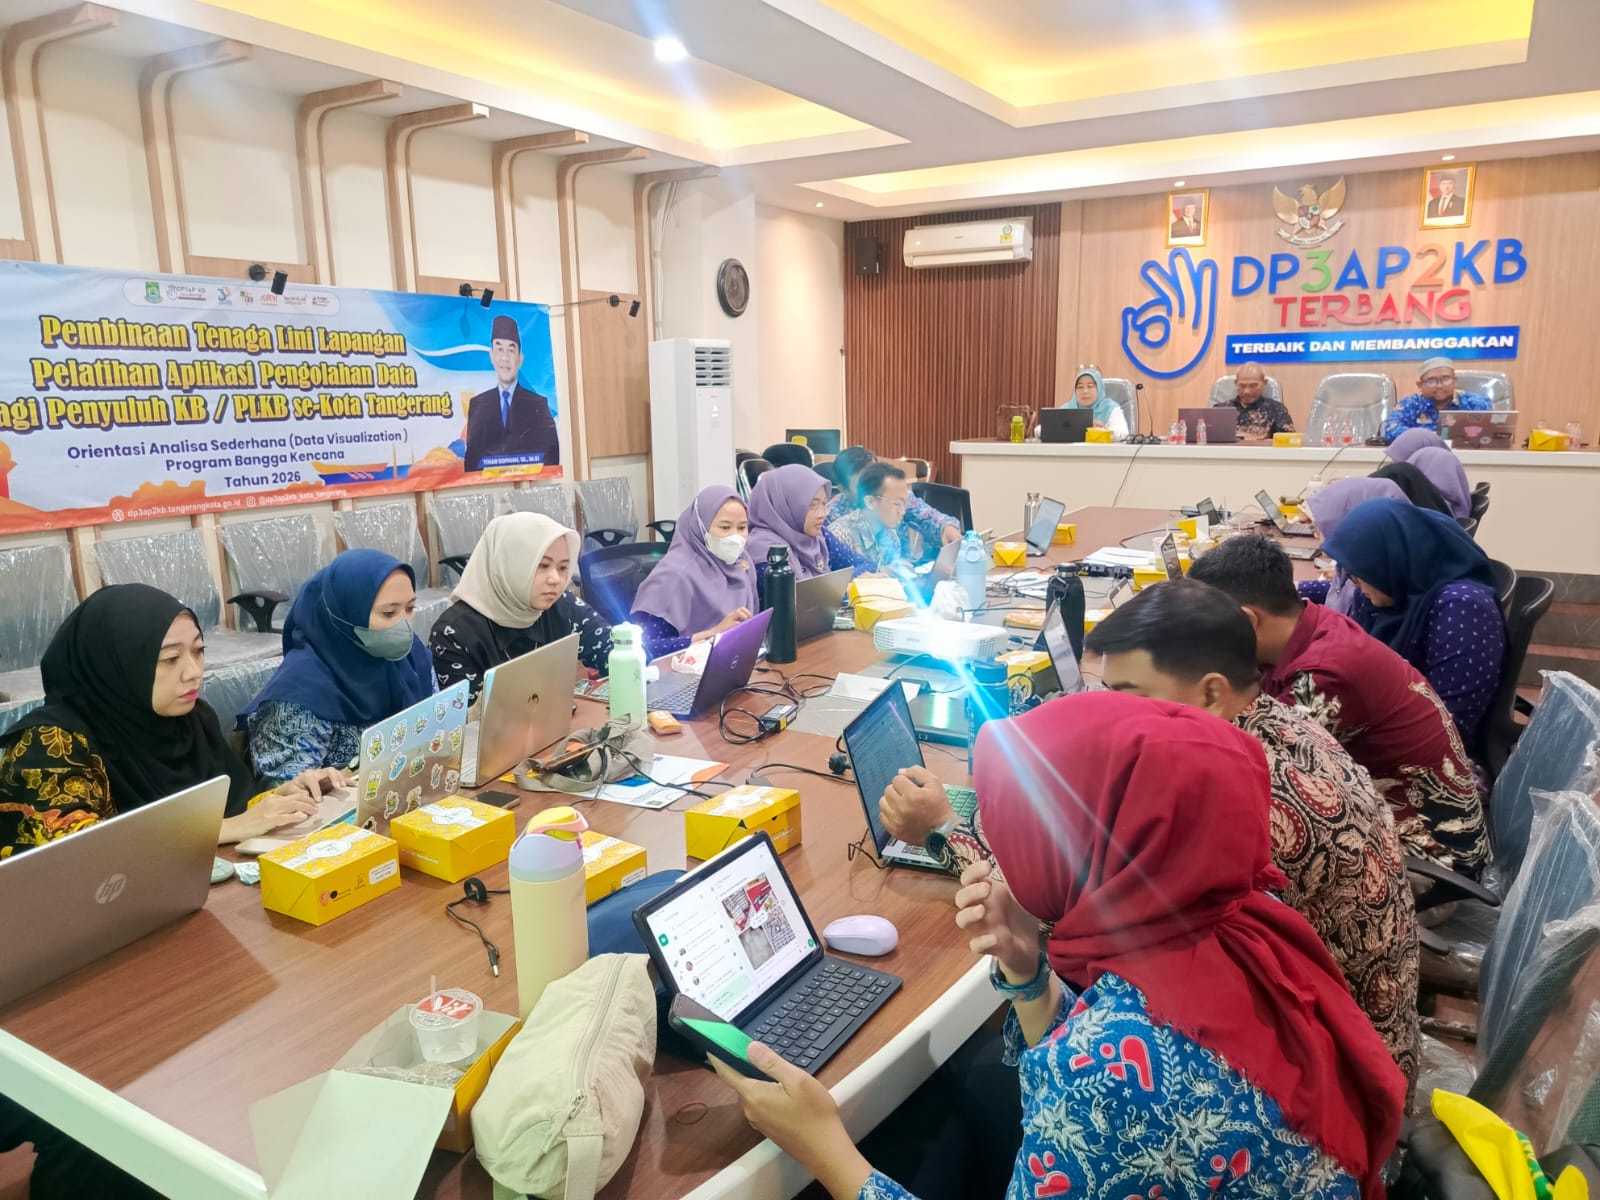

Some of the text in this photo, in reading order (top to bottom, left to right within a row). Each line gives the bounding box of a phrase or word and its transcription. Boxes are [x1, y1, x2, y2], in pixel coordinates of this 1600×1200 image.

[1232, 238, 1528, 297] DP3AP2KB
[1273, 289, 1471, 327] TERBANG
[40, 315, 406, 358] Pembinaan Tenaga Lini Lapangan
[1231, 335, 1515, 355] TERBAIK DAN MEMBANGGAKAN
[30, 357, 417, 392] Pelatihan Aplikasi Pengolahan Data
[44, 394, 169, 431] Penyuluh
[172, 394, 209, 424] KB
[214, 395, 229, 424] /
[232, 393, 289, 421] PLKB
[293, 393, 362, 420] se-Kota
[365, 391, 453, 419] Tangerang
[67, 442, 146, 459] Orientasi
[149, 439, 208, 455] Analisa
[211, 436, 287, 452] Sederhana
[289, 433, 325, 450] (Data
[327, 430, 402, 446] Visualization
[166, 449, 345, 473] Program Bangga Kencana
[224, 471, 301, 488] Tahun 2026
[127, 498, 241, 518] dp3ap2kb.tangerangkota.go.id
[96, 873, 127, 905] hp
